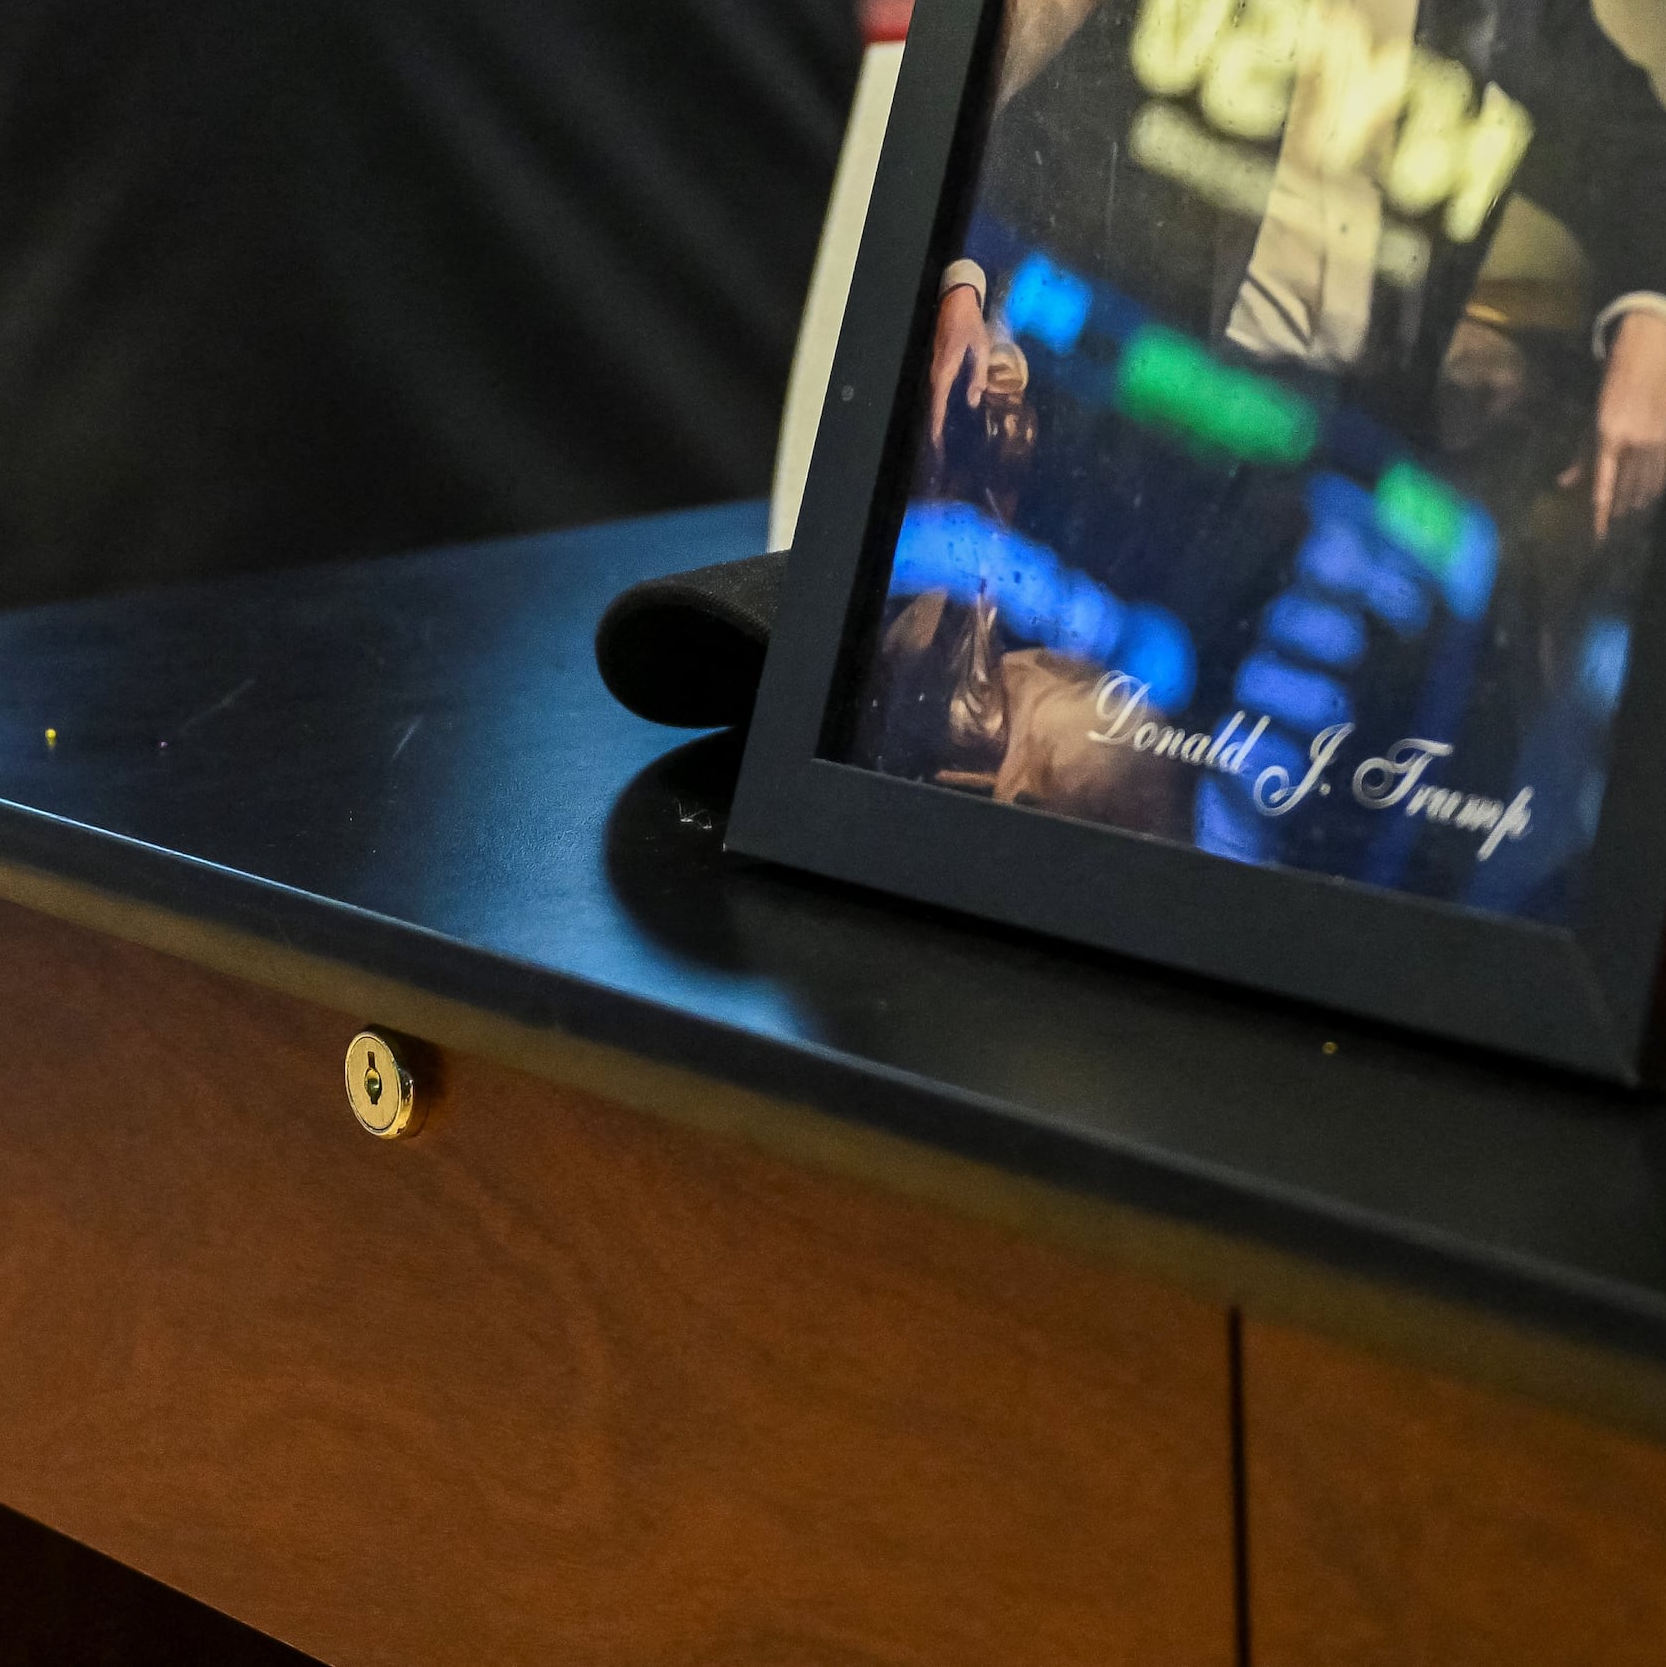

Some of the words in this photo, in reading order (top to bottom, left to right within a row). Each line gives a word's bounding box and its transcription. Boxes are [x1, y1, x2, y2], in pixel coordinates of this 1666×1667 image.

[1087, 669, 1271, 774] Donald
[1253, 722, 1355, 817] J.
[1353, 737, 1534, 861] Trump
